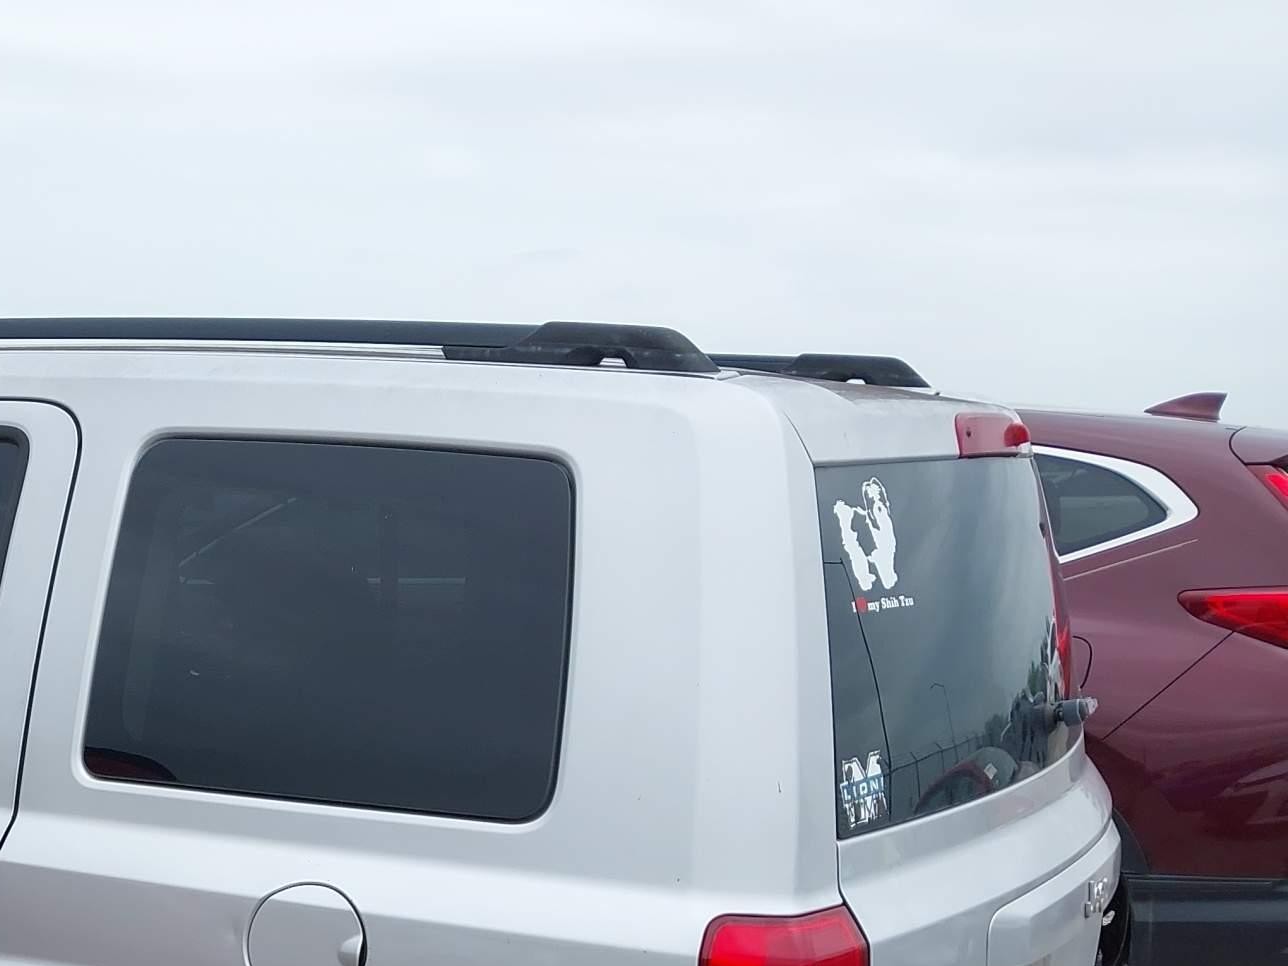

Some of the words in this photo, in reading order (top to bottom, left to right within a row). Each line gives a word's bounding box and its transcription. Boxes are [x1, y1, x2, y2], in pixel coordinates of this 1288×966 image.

[867, 601, 880, 613] my
[881, 597, 900, 609] Shih
[899, 595, 914, 607] Tzu
